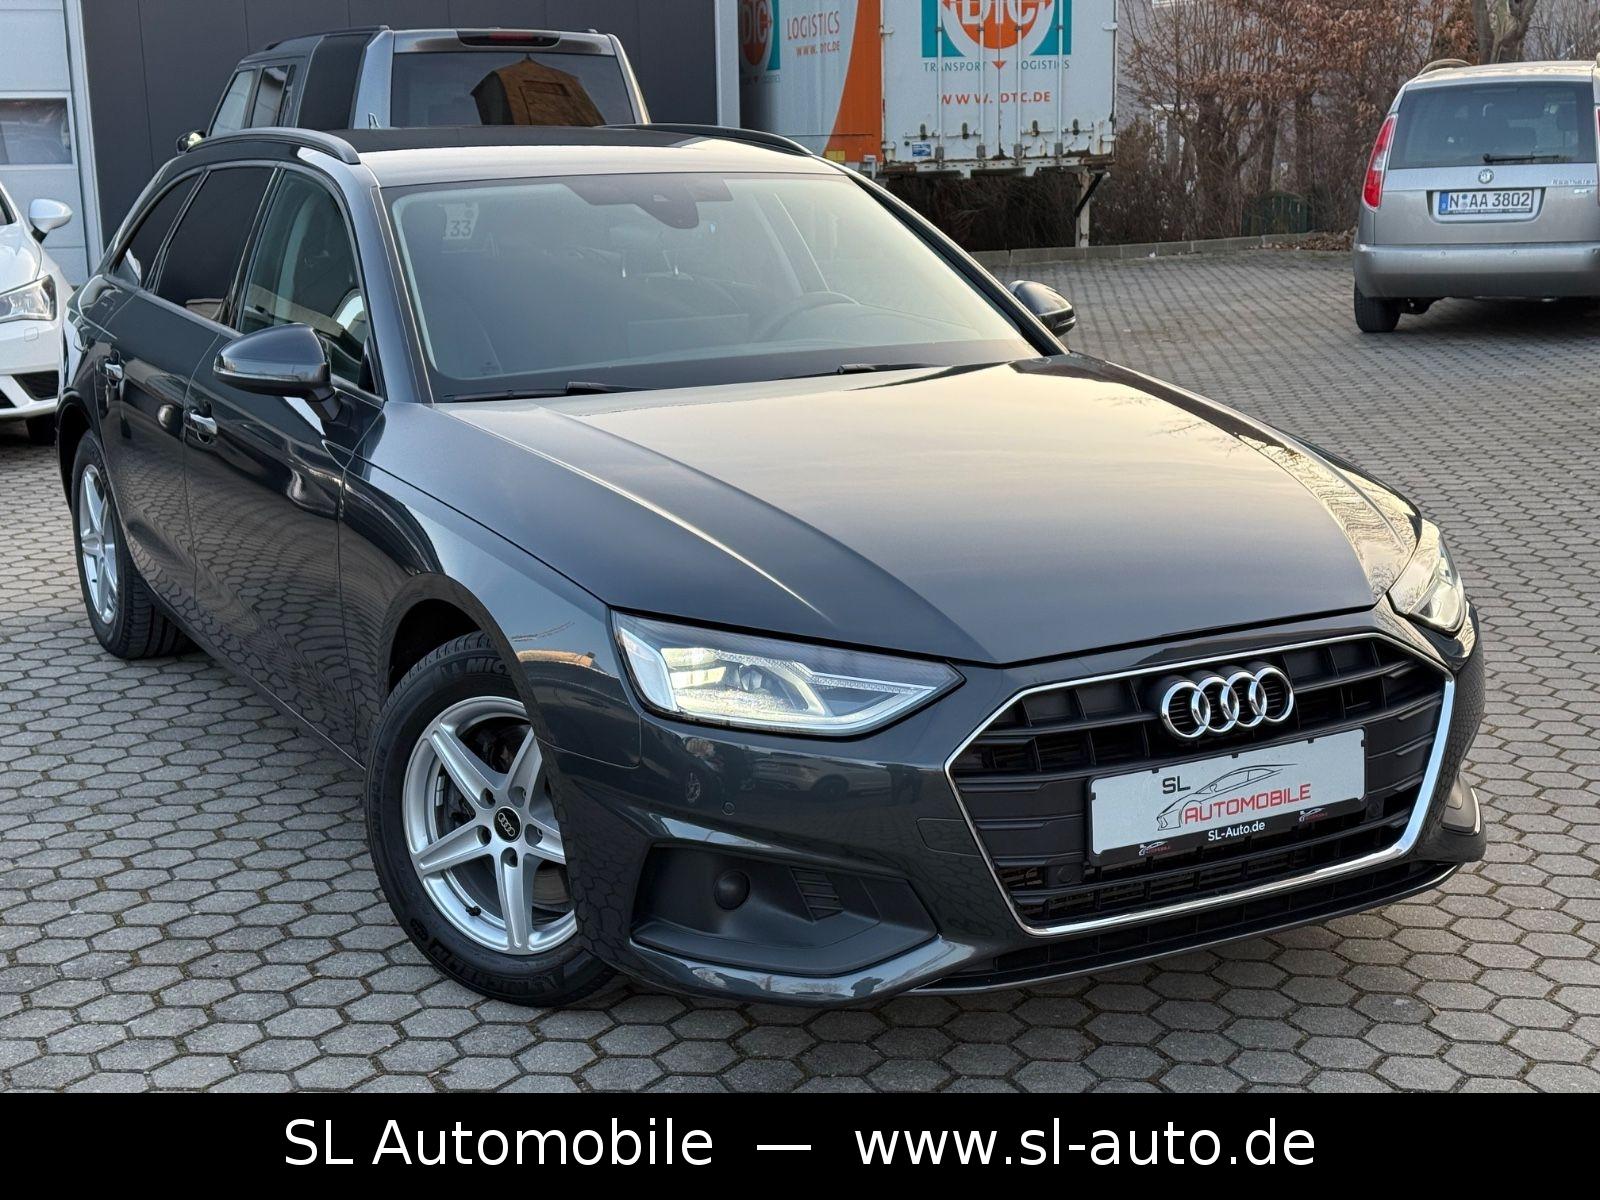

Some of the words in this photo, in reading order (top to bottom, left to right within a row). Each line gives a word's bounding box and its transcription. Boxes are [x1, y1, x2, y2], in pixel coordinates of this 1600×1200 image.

[787, 11, 840, 40] LOGISTICS
[924, 61, 987, 72] TRNSPORT
[1016, 60, 1070, 70] LOGISTIS
[1001, 91, 1051, 103] DTC.DE
[1469, 193, 1488, 208] AA
[1492, 192, 1530, 207] 3802
[450, 220, 471, 237] 33
[1162, 775, 1190, 794] SL
[1184, 783, 1311, 824] AUTOMOBILE
[1208, 821, 1265, 842] SL-Auto.de
